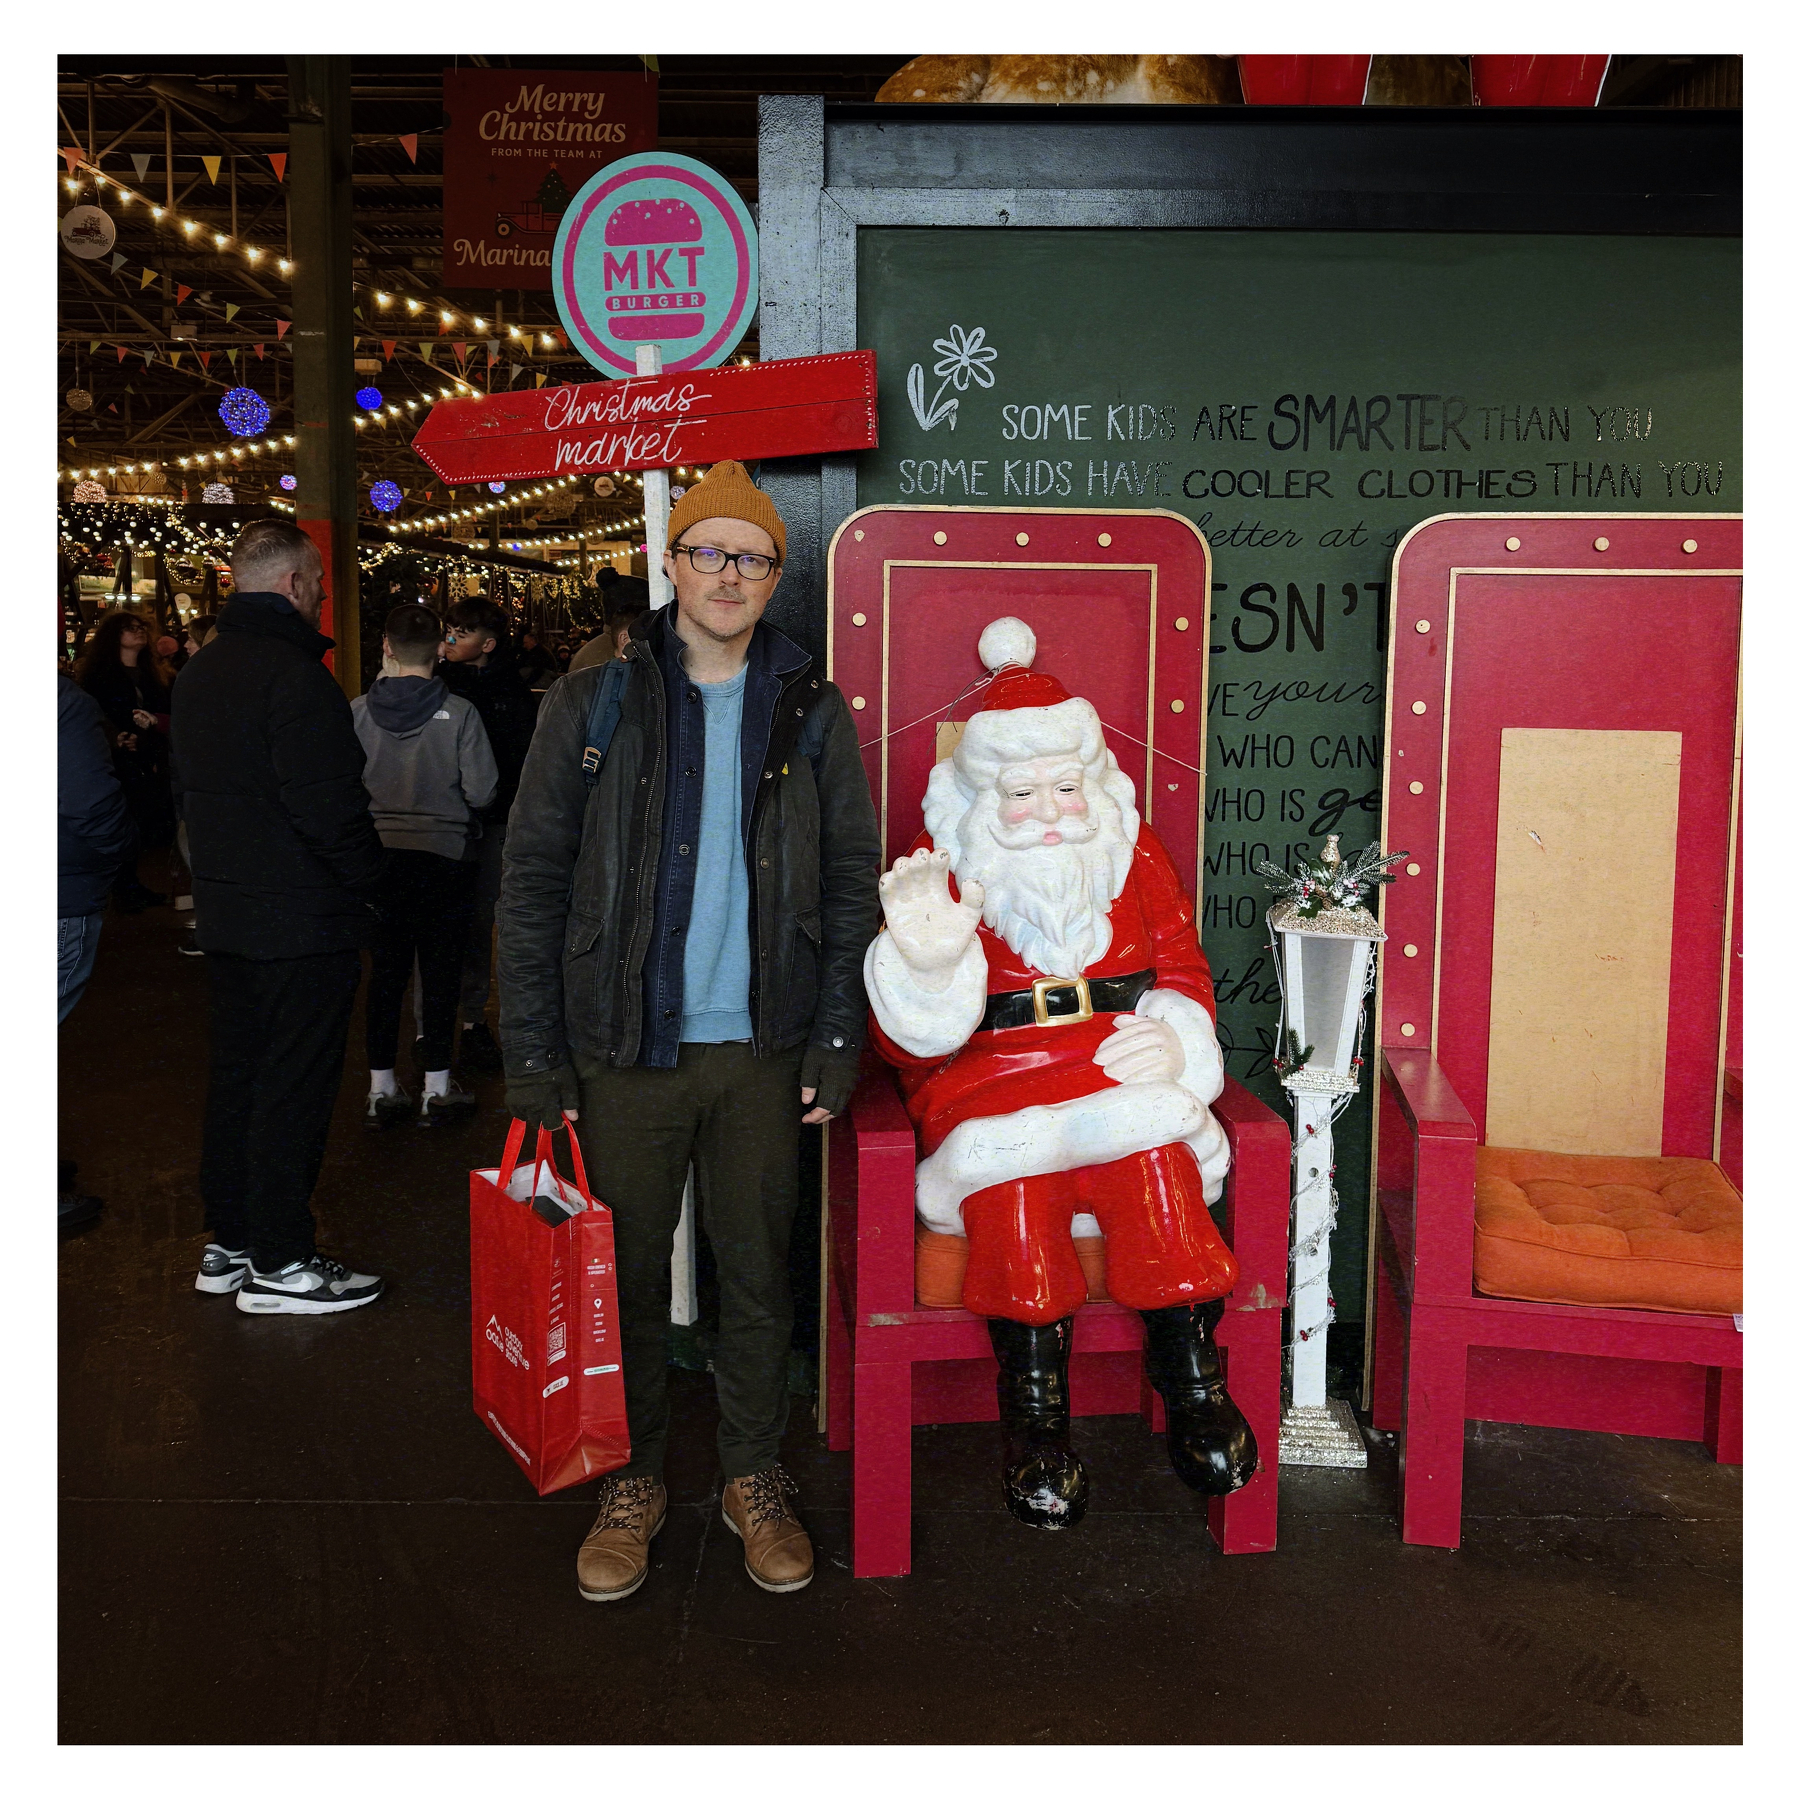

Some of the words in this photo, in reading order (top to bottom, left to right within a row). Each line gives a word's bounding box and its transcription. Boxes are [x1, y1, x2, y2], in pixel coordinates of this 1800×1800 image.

[504, 83, 606, 120] Merry
[478, 109, 627, 143] Christmas
[491, 147, 522, 158] FROM
[527, 148, 549, 158] THE
[553, 149, 585, 159] TEAM
[588, 150, 603, 159] AT
[453, 238, 551, 267] Marina
[603, 246, 705, 292] MKT
[612, 294, 700, 310] BURGER
[544, 380, 713, 431] Christmas
[1002, 403, 1092, 441] SOME
[1107, 403, 1177, 442] KIDS
[1191, 404, 1259, 442] ARE
[1267, 394, 1472, 453] SMARTER
[1476, 404, 1571, 443] THAN
[1587, 404, 1653, 443] YOU
[555, 419, 708, 472] market
[899, 458, 989, 497] SOME
[1003, 459, 1073, 497] KIDS
[1087, 460, 1174, 498] HAVE
[1182, 468, 1335, 500] COOLER
[1357, 468, 1539, 500] CLOTHES
[1545, 460, 1643, 499] THAN
[1656, 460, 1724, 499] YOU
[1197, 511, 1303, 548] better
[1318, 520, 1369, 547] at
[1242, 680, 1383, 721] your
[1216, 733, 1295, 769] WHO
[1309, 734, 1379, 770] CAN
[1204, 787, 1265, 822] WHO
[1280, 788, 1306, 822] IS
[1285, 842, 1311, 878] IS
